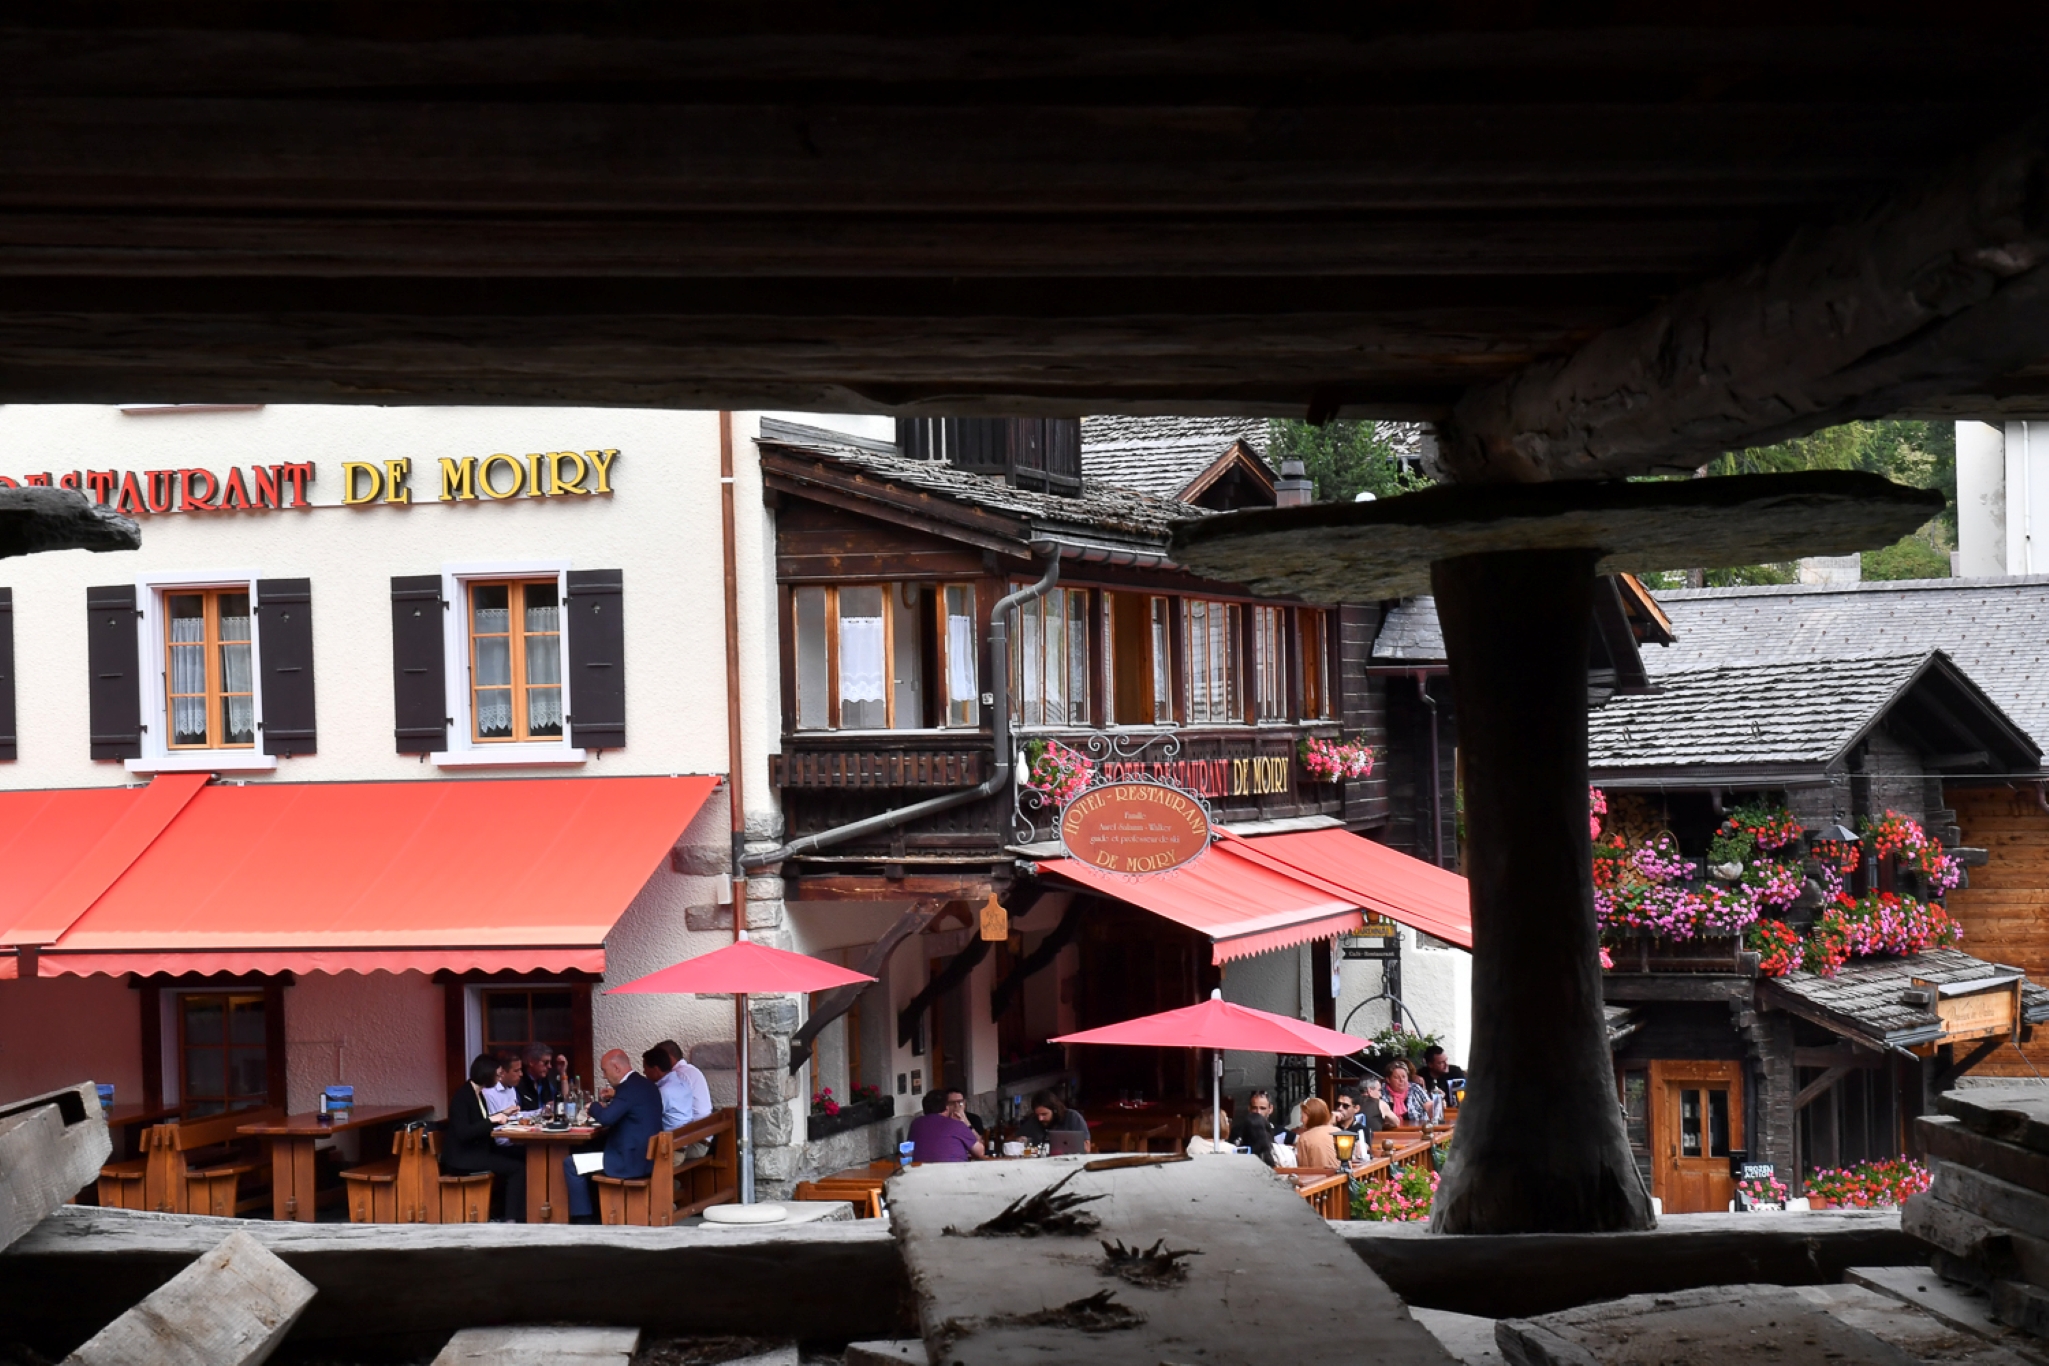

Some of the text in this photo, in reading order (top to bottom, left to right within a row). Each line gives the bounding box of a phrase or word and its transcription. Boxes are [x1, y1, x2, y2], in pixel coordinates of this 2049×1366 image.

[341, 457, 411, 505] DE
[438, 449, 620, 501] MOIRY
[1233, 758, 1249, 796] DE
[1253, 756, 1288, 794] MOIRY
[1063, 792, 1106, 835] HOTEL
[1115, 786, 1207, 837] RESTAURANT
[1096, 849, 1176, 872] DE MOIRY
